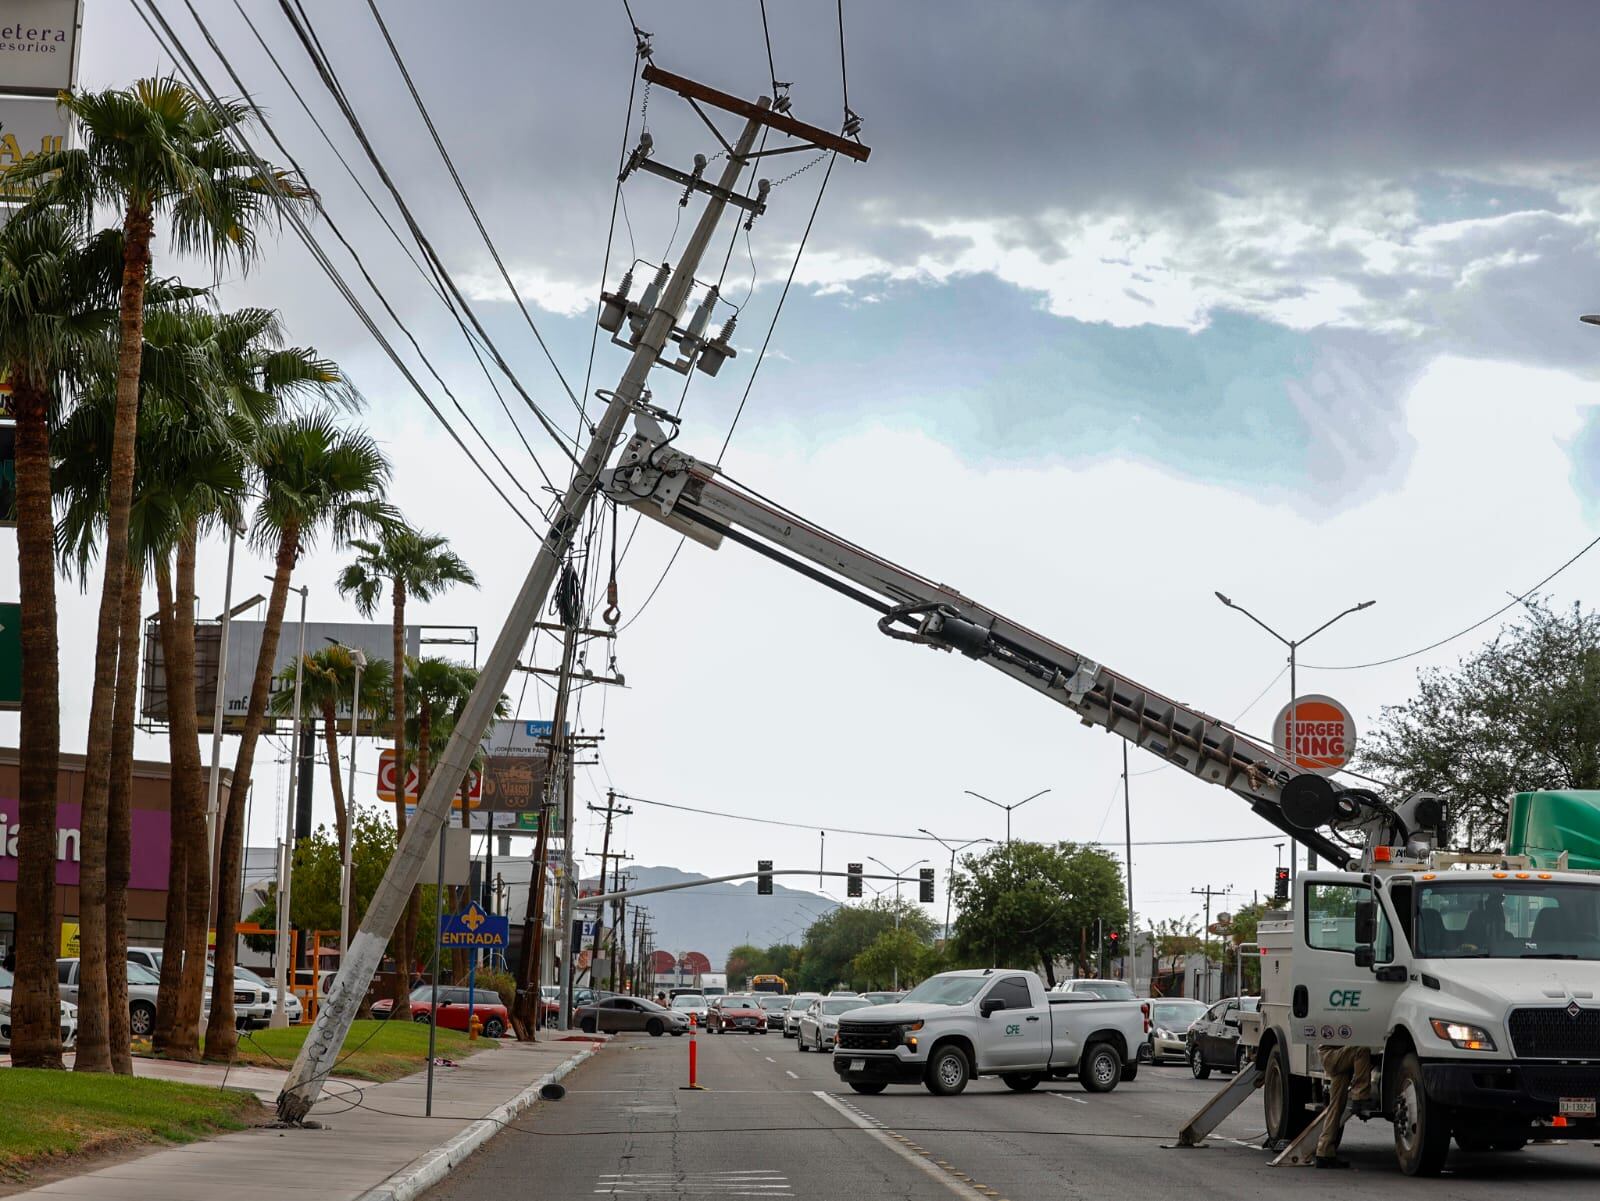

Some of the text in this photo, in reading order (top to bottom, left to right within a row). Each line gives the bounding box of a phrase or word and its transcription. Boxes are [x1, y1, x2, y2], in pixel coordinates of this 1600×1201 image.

[1, 24, 66, 42] etera
[0, 41, 57, 54] esorios
[1285, 722, 1345, 736] BURGER
[1285, 736, 1345, 756] KING
[442, 932, 503, 945] ENTRADA
[1329, 989, 1362, 1007] CFE
[1005, 1024, 1020, 1035] CFE
